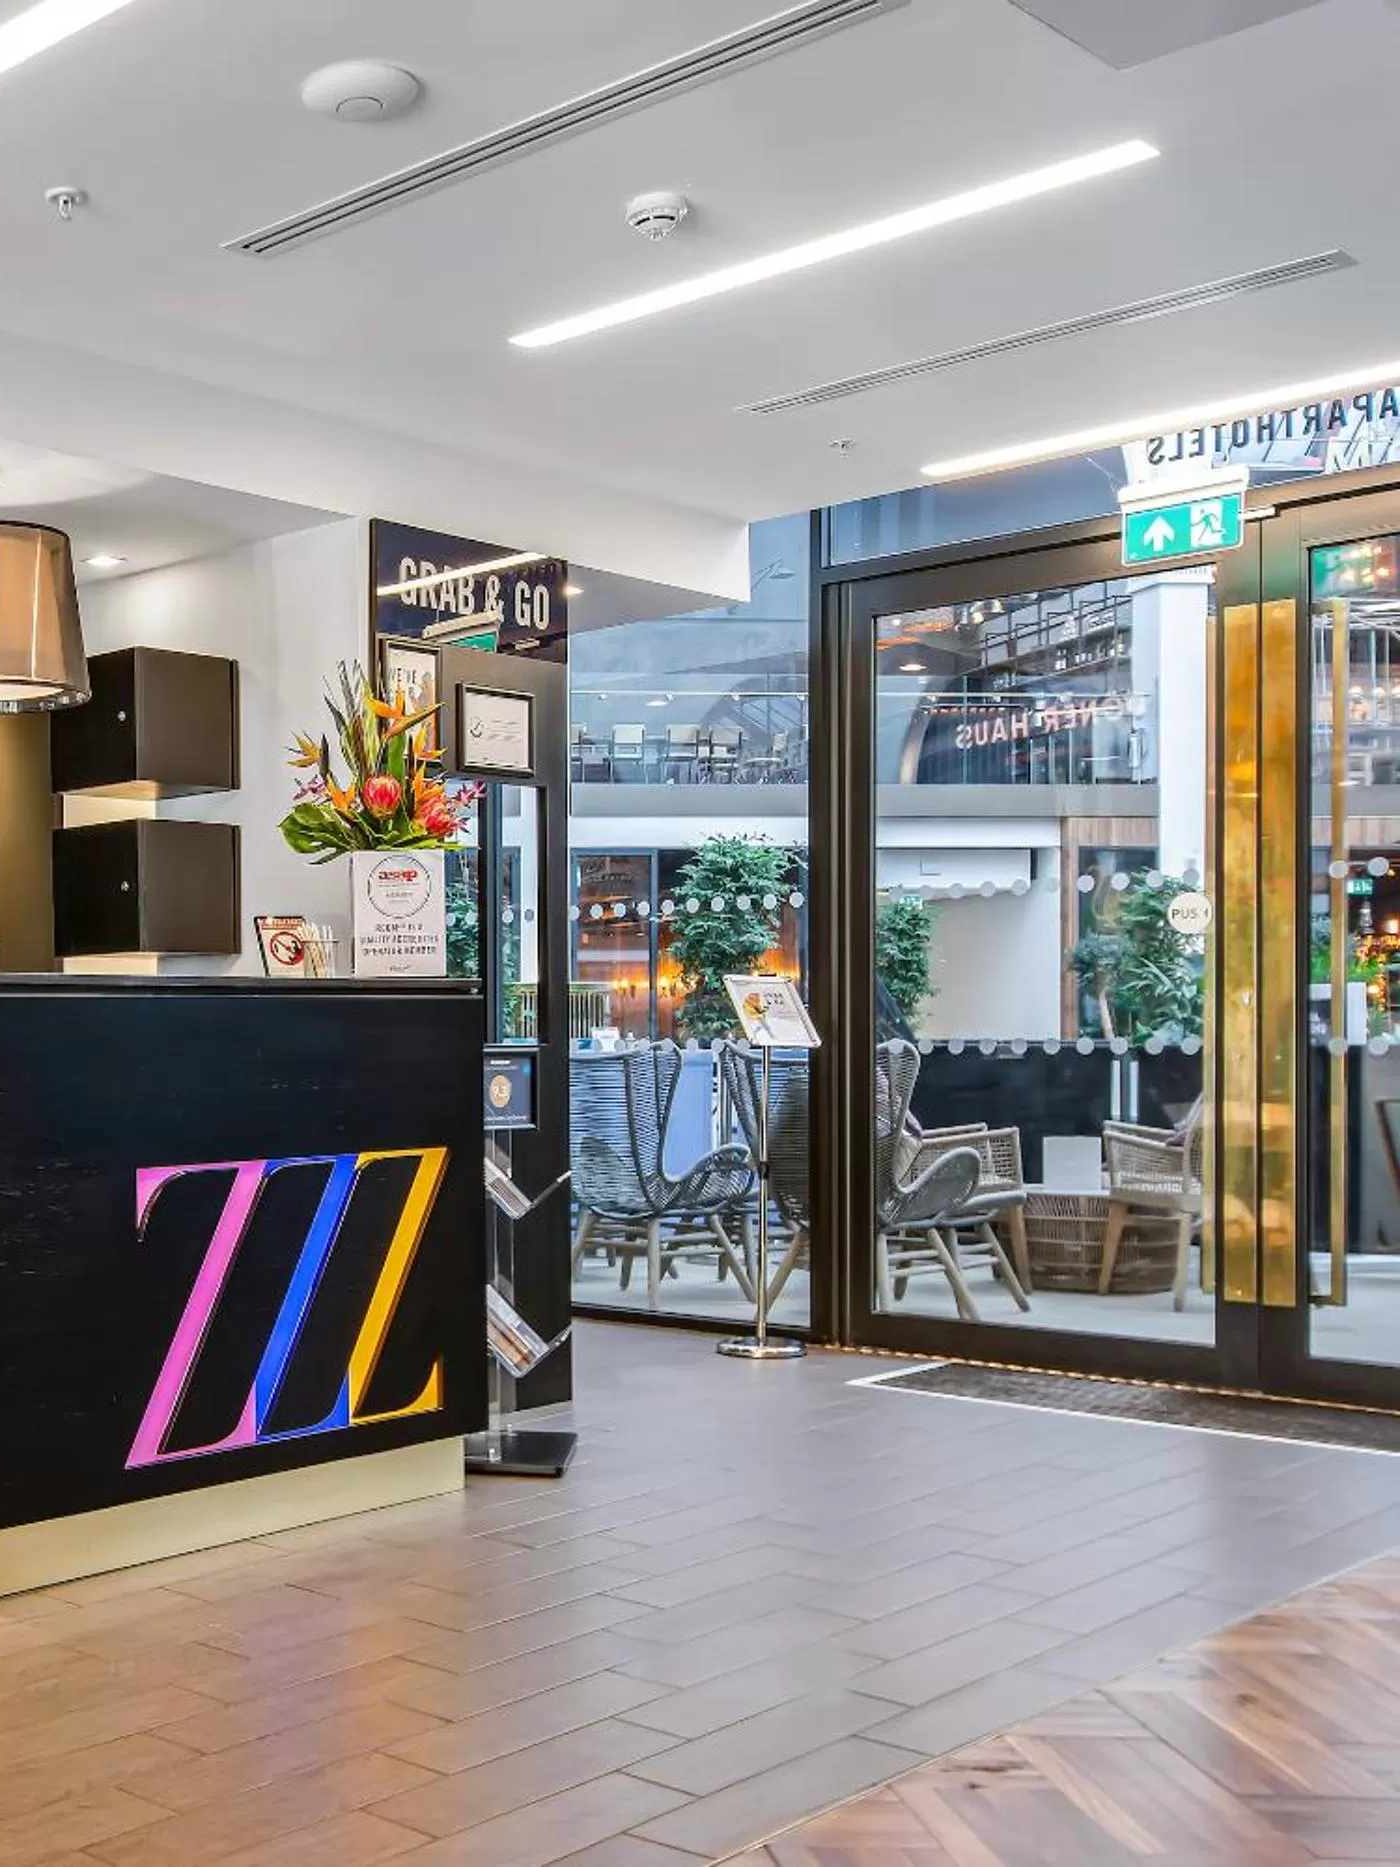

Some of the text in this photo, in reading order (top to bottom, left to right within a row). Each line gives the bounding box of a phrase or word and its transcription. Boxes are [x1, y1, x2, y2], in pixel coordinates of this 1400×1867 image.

[399, 556, 550, 630] GRAB & GO
